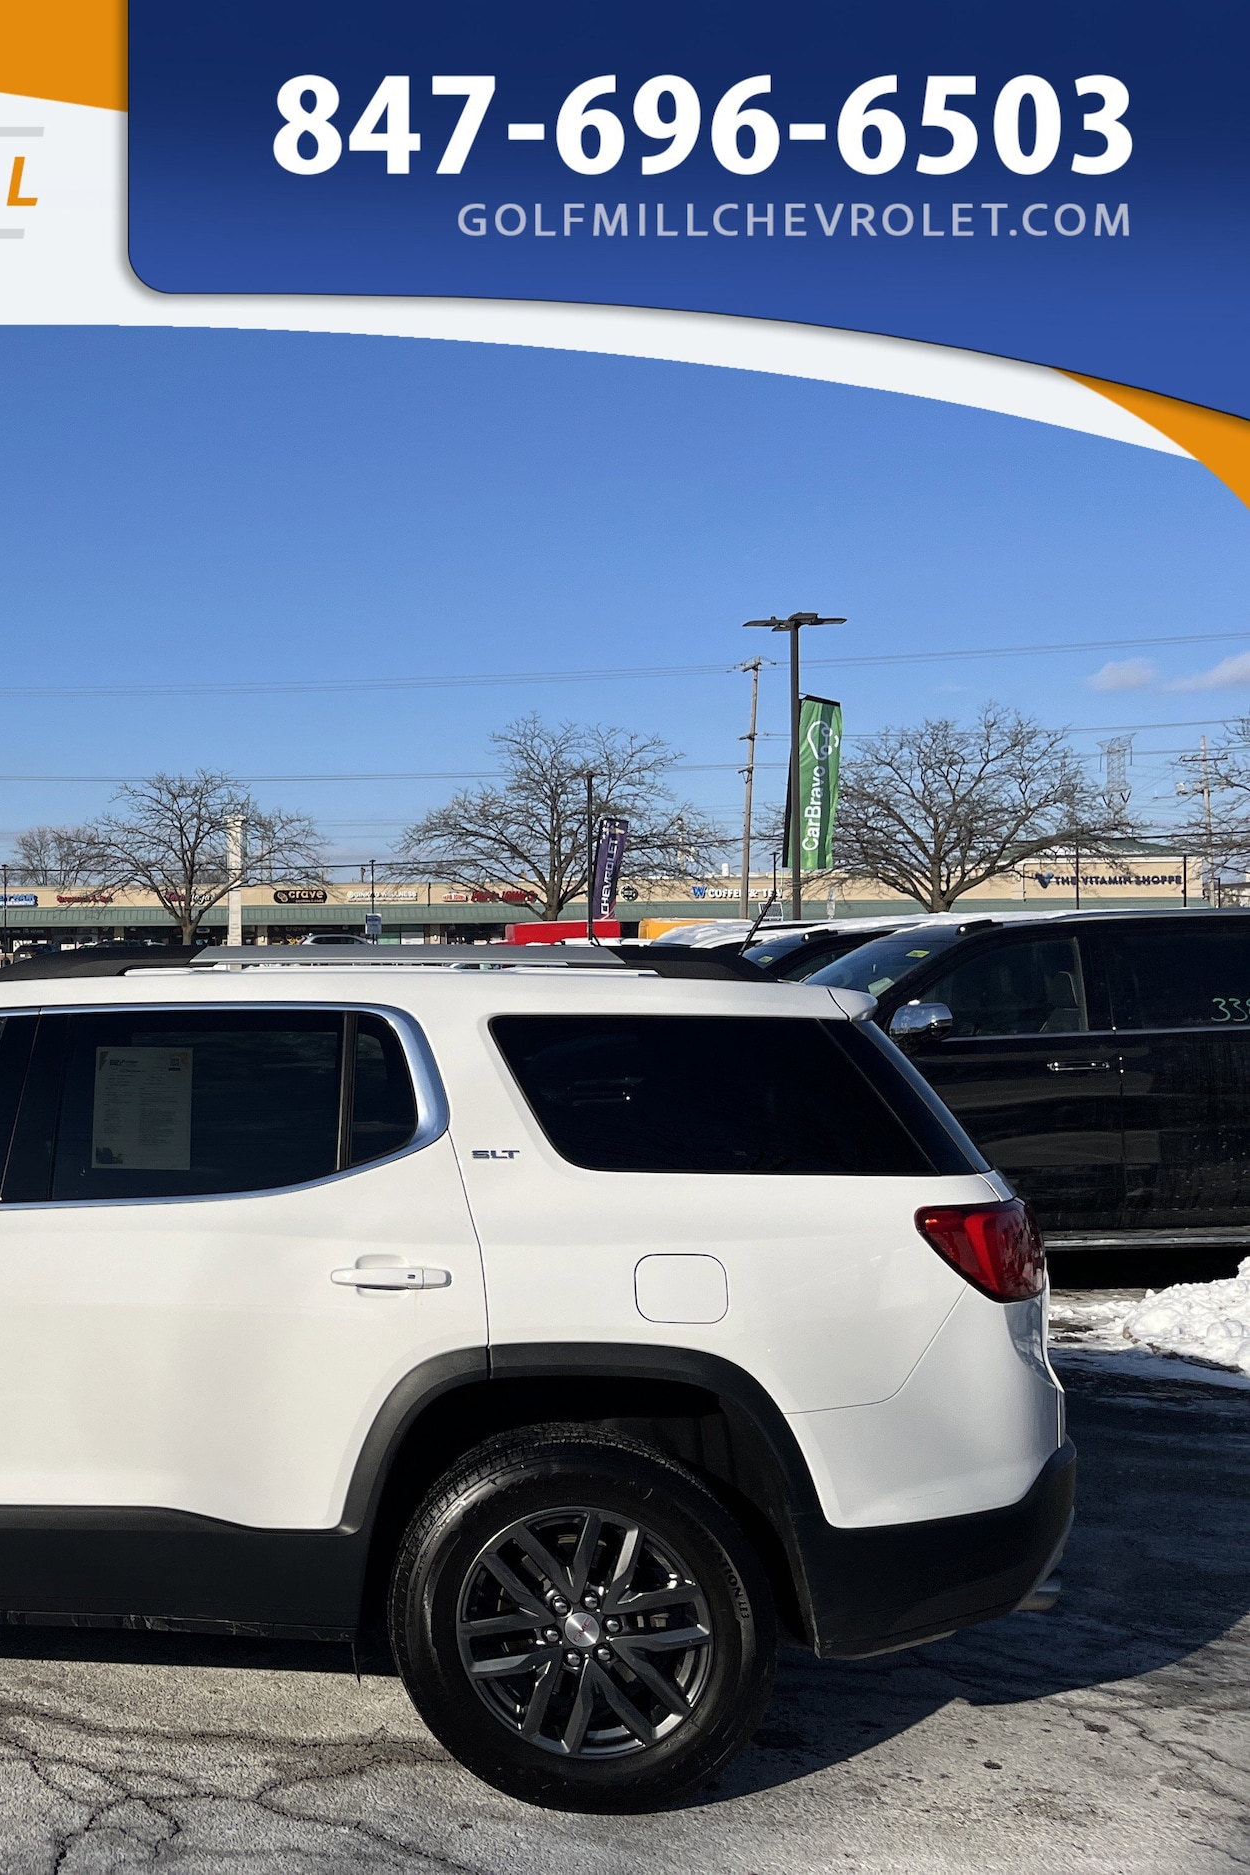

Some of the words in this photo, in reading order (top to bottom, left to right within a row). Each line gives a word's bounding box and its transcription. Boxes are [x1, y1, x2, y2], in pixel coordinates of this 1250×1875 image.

[801, 765, 826, 851] CarBravo
[600, 837, 618, 914] CHEVROLET
[1054, 875, 1077, 886] THE
[1081, 875, 1131, 886] VITAMIN
[1134, 875, 1183, 886] SHOPPE
[288, 890, 324, 898] crave
[708, 888, 745, 898] COFFE
[471, 1150, 520, 1159] SLT
[573, 1616, 592, 1642] GMC
